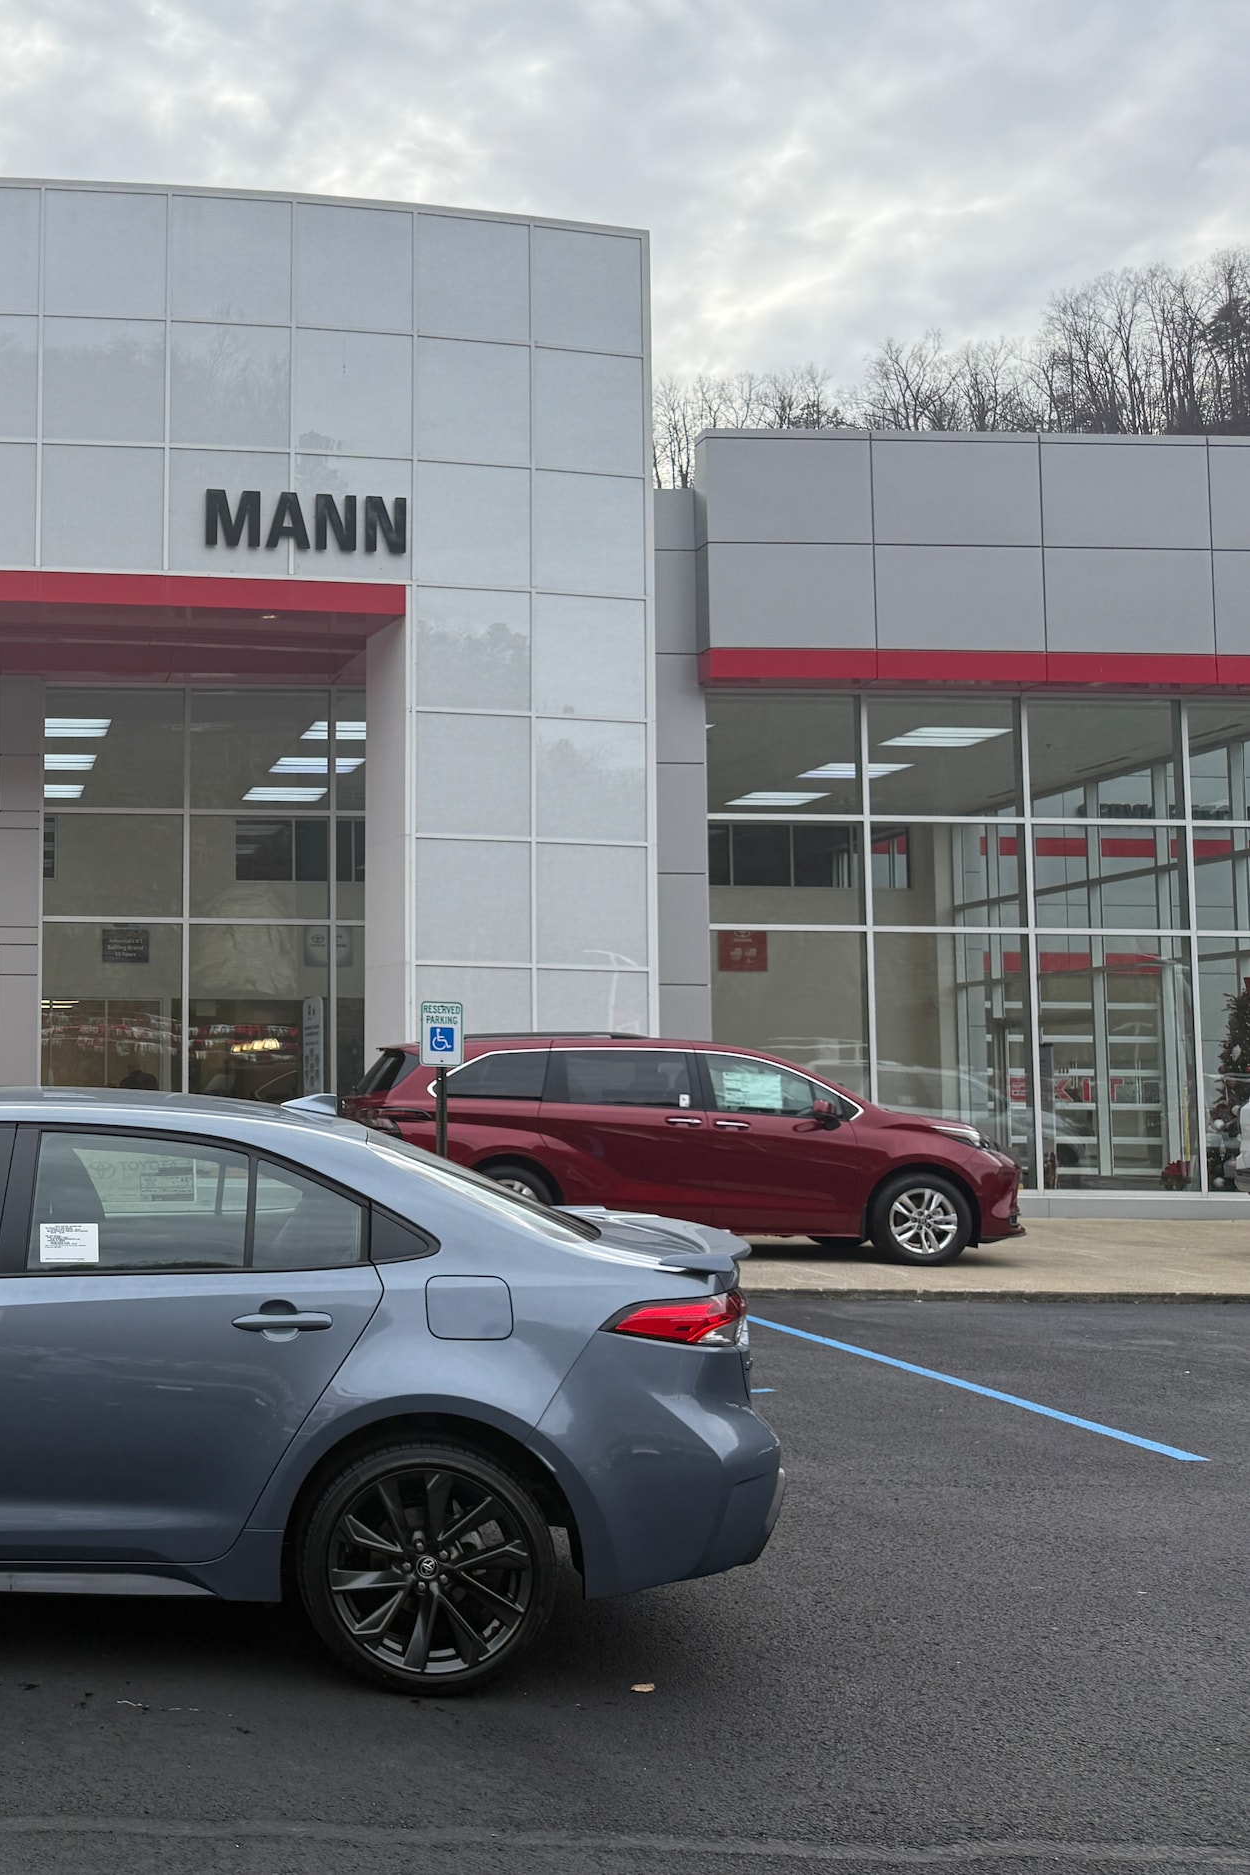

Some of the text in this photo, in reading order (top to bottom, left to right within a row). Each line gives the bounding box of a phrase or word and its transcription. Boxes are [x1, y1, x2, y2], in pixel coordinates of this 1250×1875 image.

[205, 488, 407, 553] MANN
[423, 1005, 461, 1014] RESERVED
[426, 1015, 458, 1025] PARKING
